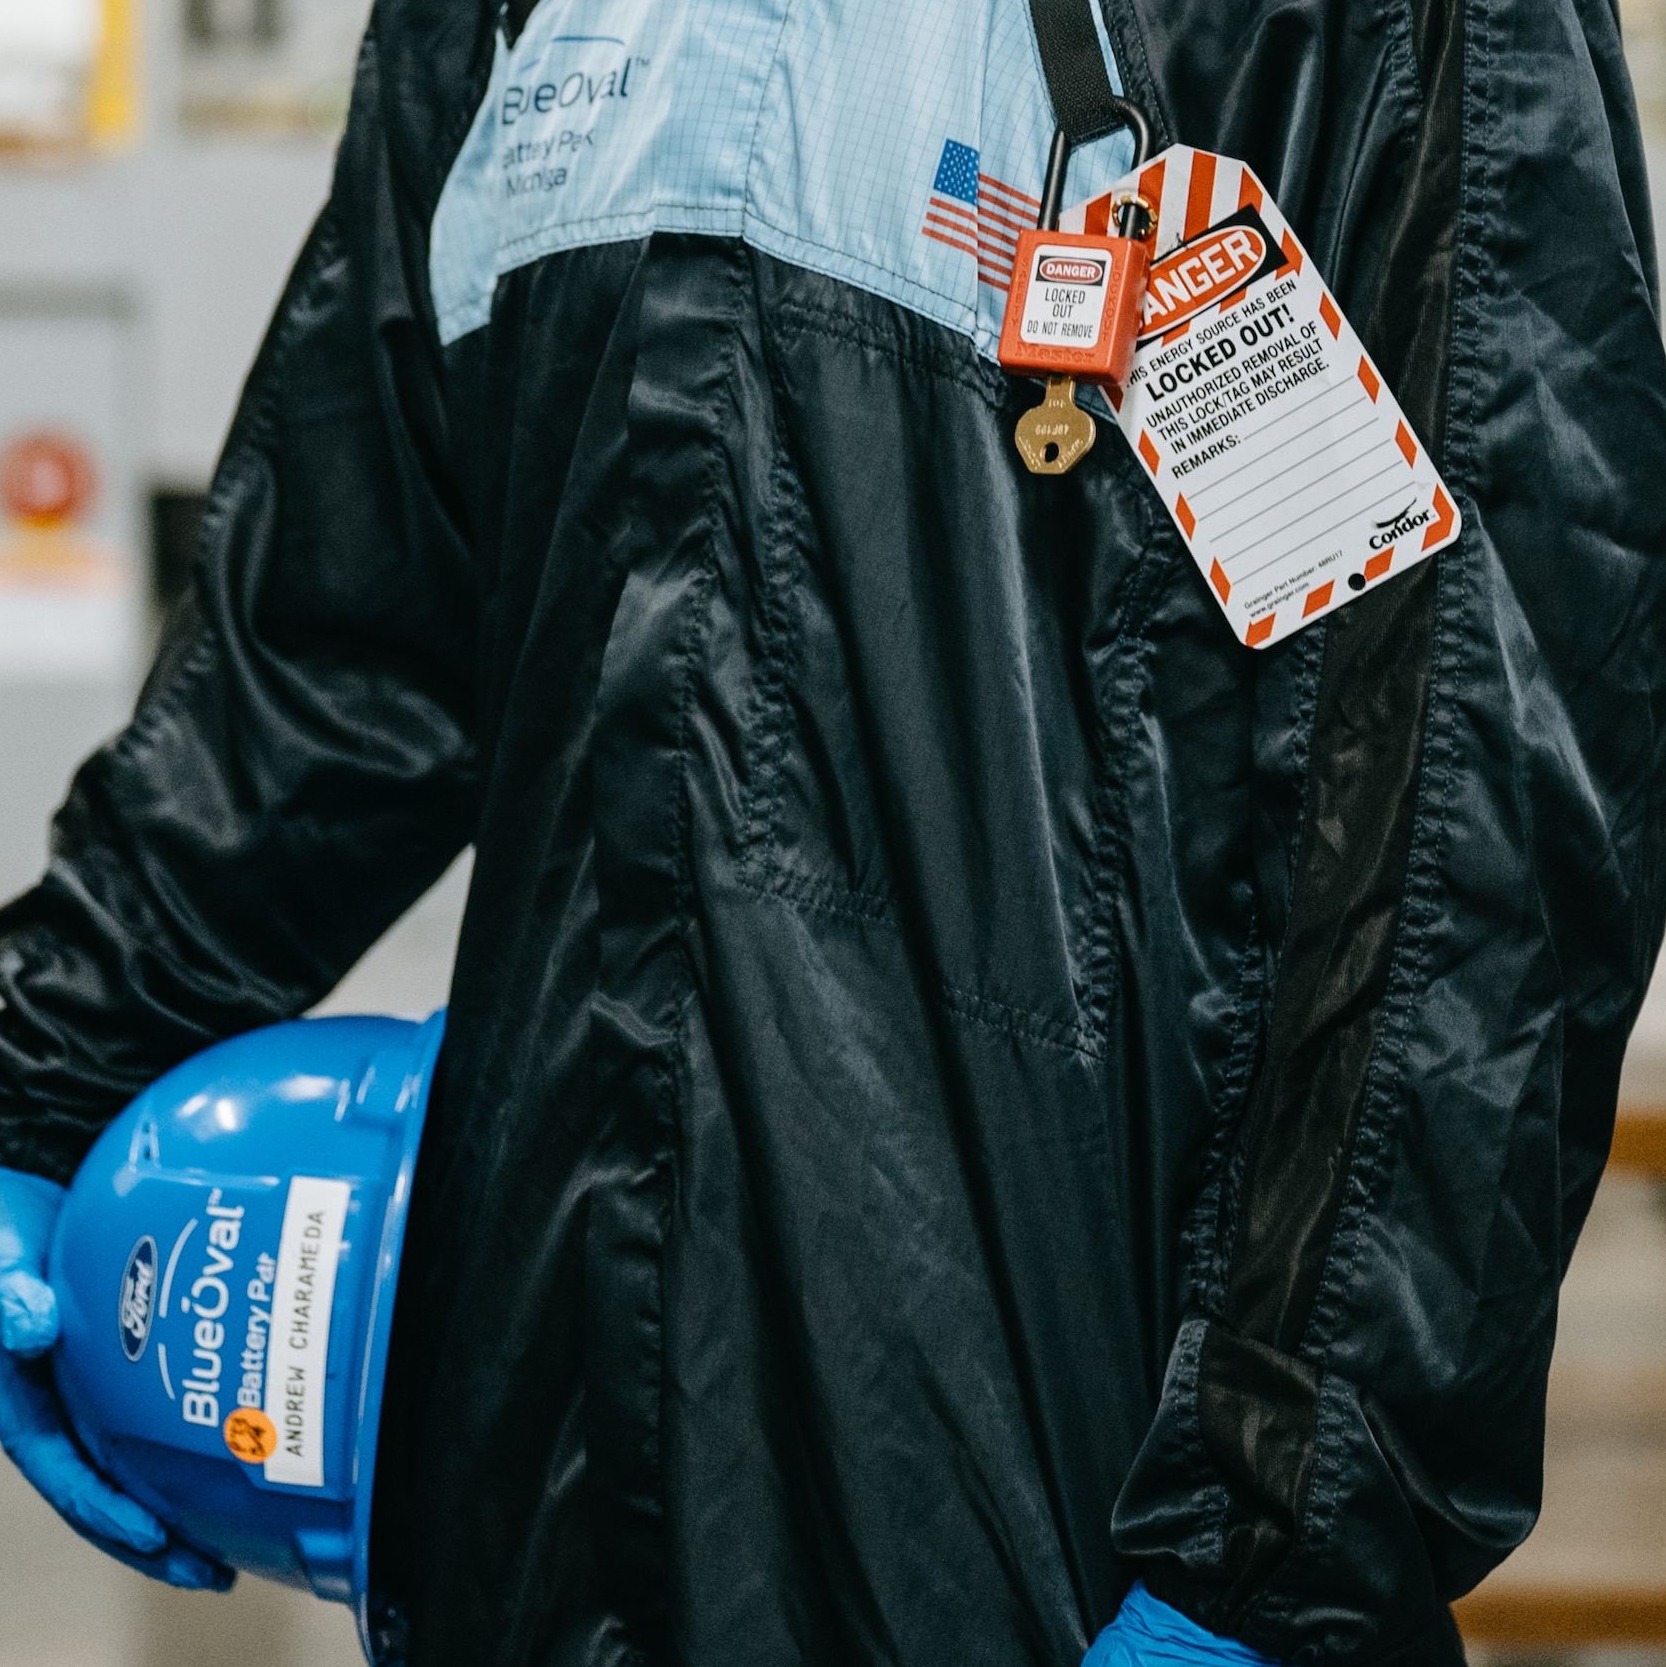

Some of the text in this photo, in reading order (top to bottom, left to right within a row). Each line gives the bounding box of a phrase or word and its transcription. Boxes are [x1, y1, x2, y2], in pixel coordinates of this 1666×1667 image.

[1012, 257, 1029, 326] SAFETY
[1045, 288, 1086, 304] LOCKED
[1046, 263, 1096, 278] DANGER
[1102, 259, 1122, 342] LOCKOUT
[1139, 231, 1259, 330] ANGER
[1027, 320, 1093, 338] DO NOT REMOVE
[1052, 304, 1074, 318] OUT
[1127, 278, 1297, 388] HIS ENERGY SOURCE HAS BEEN
[1015, 342, 1095, 363] Master
[1145, 303, 1294, 402] LOCKED OUT!
[1146, 321, 1318, 428] UNAUTHORIZED REMOVAL OF
[1157, 338, 1323, 442] THIS LOCK/TAG MAY RESULT
[1171, 357, 1330, 455] IN IMMEDIATE DISCHARGE.
[1171, 433, 1241, 479] REMARKS:
[1369, 508, 1430, 550] Condor
[1244, 589, 1273, 609] Grainger
[1274, 579, 1289, 593] Part
[1289, 566, 1318, 585] Number:
[1250, 582, 1310, 618] www.grainger.com
[122, 1258, 154, 1339] Ford
[285, 1209, 326, 1457] ANDREW CHARAMEDA
[236, 1304, 271, 1409] Battery
